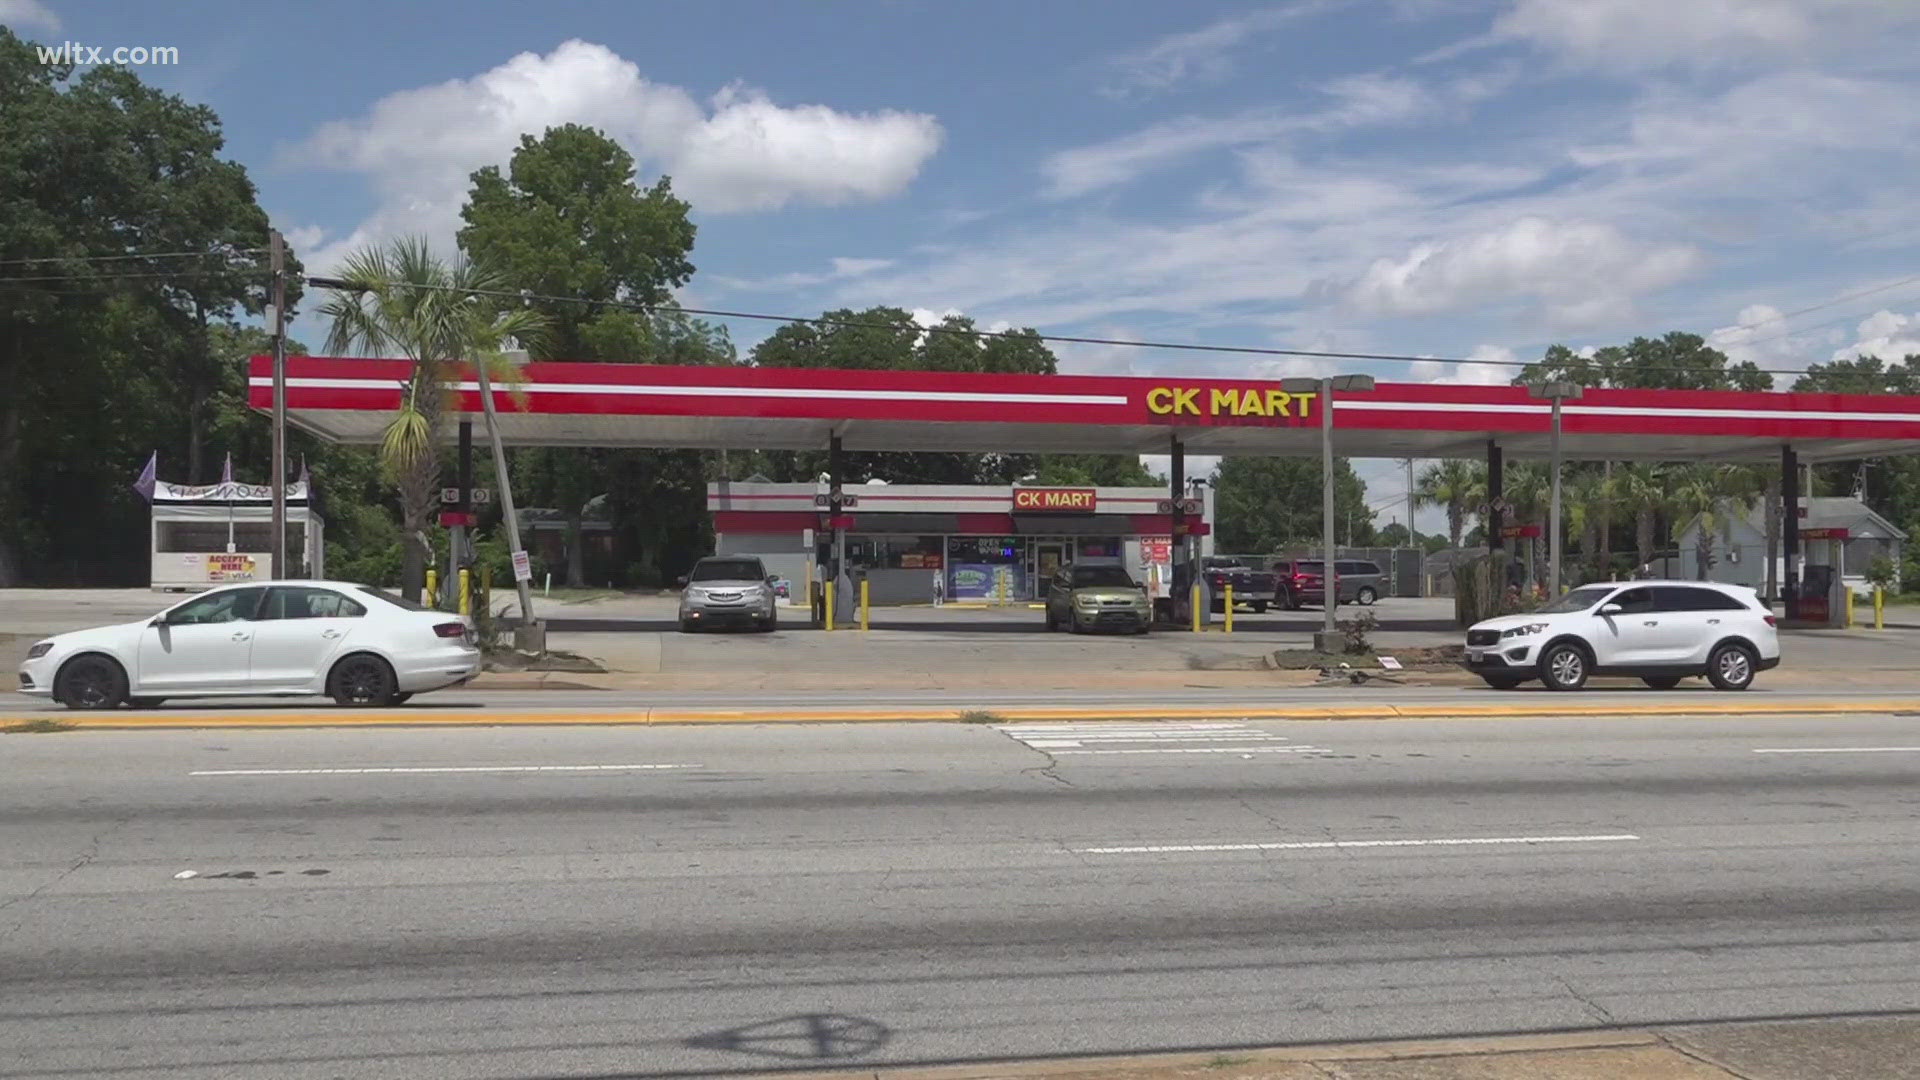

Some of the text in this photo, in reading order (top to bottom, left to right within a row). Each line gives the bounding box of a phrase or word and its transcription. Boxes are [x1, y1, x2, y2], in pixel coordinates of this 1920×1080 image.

[1146, 388, 1317, 417] CK MART
[167, 484, 298, 498] FIREWORS
[1017, 492, 1093, 507] CK MART
